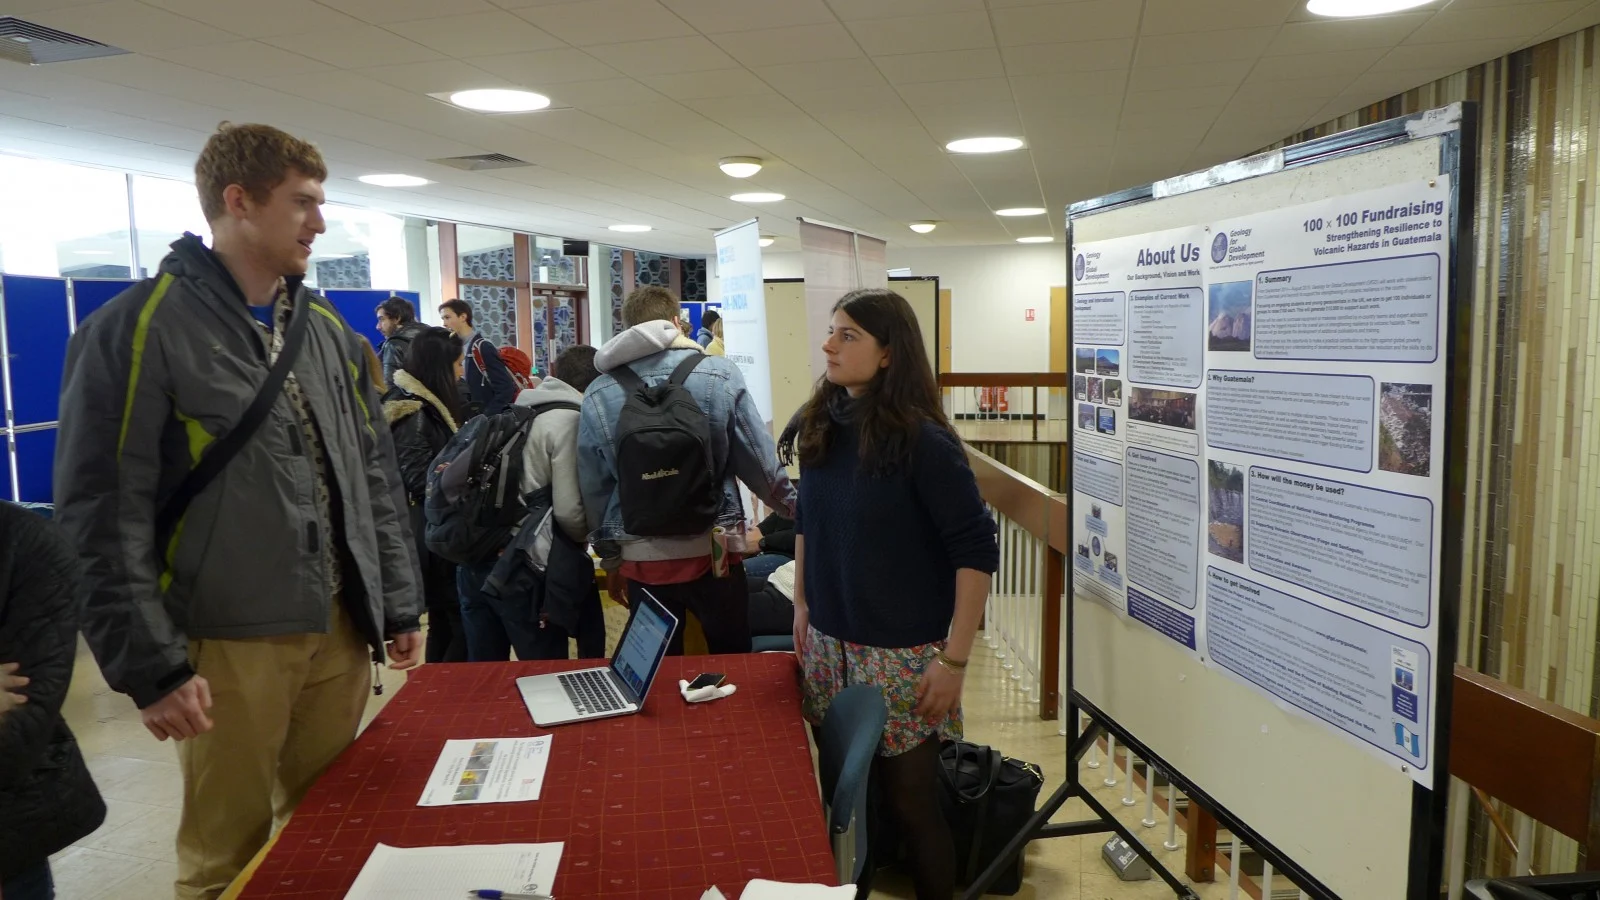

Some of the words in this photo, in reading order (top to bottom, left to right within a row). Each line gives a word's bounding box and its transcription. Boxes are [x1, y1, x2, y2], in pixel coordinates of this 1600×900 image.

[1303, 218, 1322, 232] 100
[1336, 212, 1358, 228] 100
[1362, 200, 1443, 223] Fundraising
[1229, 226, 1252, 239] Geology
[1326, 228, 1381, 242] Strengthening
[1384, 221, 1430, 235] Resilience
[1433, 219, 1442, 228] to
[1229, 243, 1246, 253] Global
[1314, 245, 1345, 256] Volcanic
[1347, 240, 1379, 252] Hazards
[1382, 239, 1389, 248] in
[1392, 232, 1442, 246] Guatemala
[1136, 246, 1175, 267] About
[1180, 242, 1200, 262] Us
[1228, 249, 1264, 262] Development
[1135, 273, 1162, 281] Background,
[1264, 274, 1291, 285] Summary
[1212, 374, 1222, 382] Why
[1223, 374, 1254, 383] Guatemala?
[1257, 471, 1269, 480] How
[1270, 474, 1281, 482] will
[1282, 476, 1292, 485] the
[1293, 479, 1313, 491] money
[1315, 482, 1323, 491] be
[1324, 484, 1344, 496] used?
[1212, 572, 1222, 581] How
[1229, 579, 1238, 589] get
[1239, 583, 1260, 596] involved
